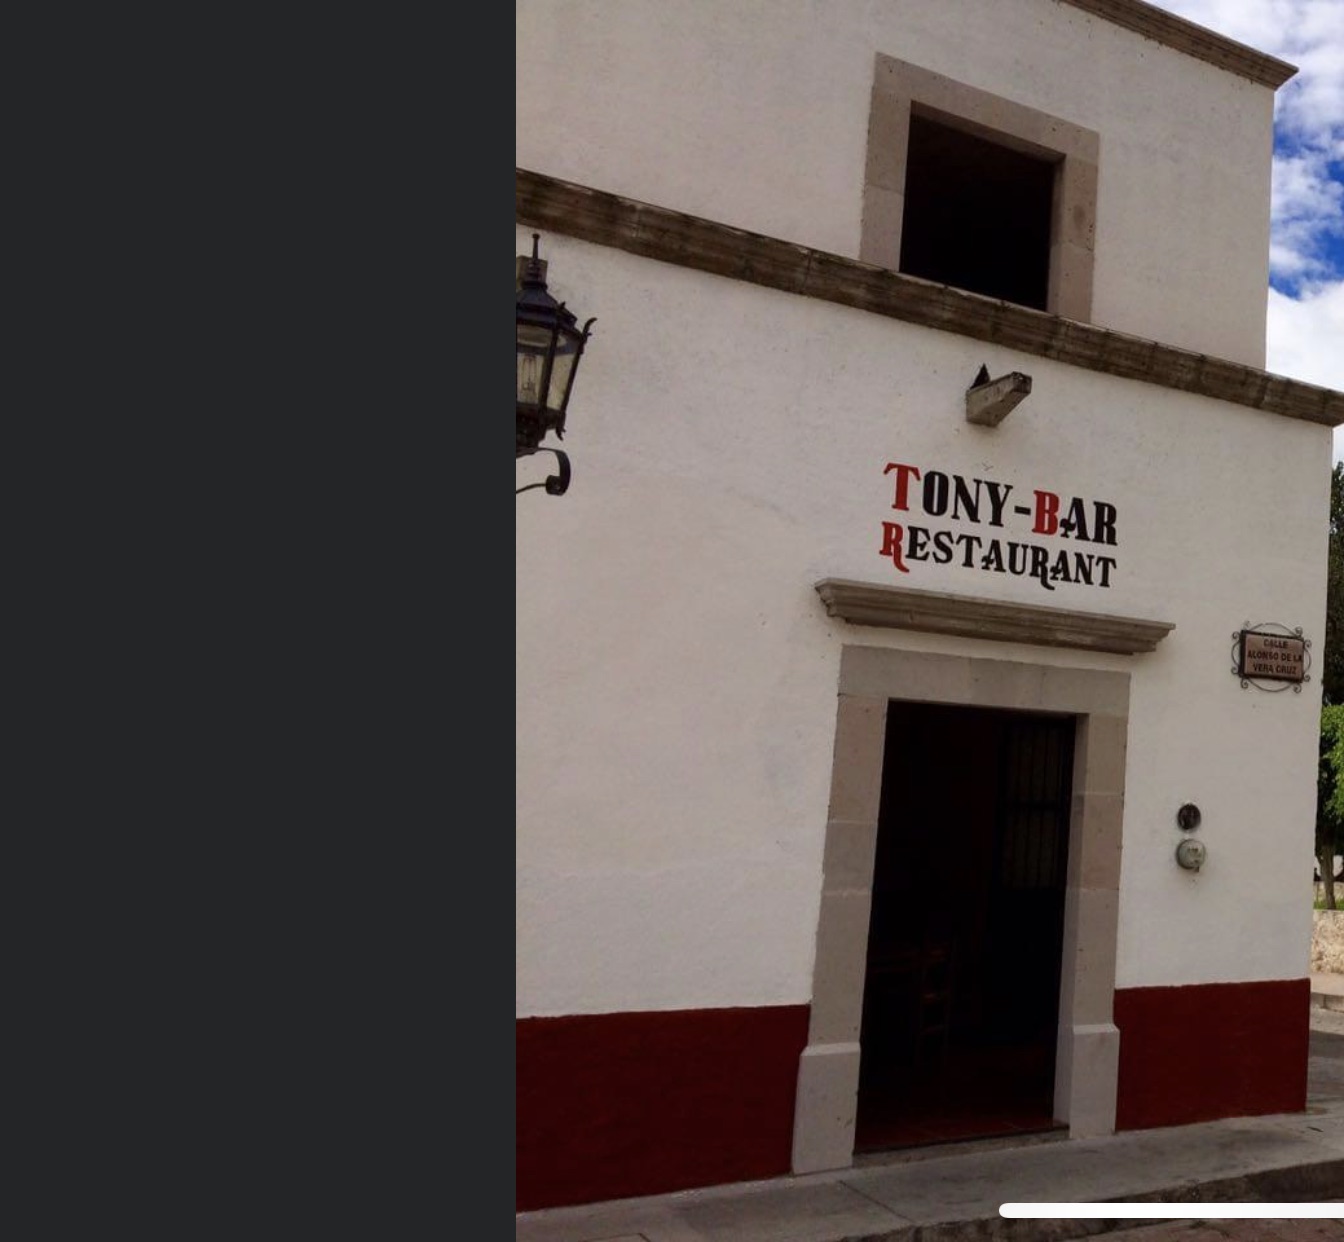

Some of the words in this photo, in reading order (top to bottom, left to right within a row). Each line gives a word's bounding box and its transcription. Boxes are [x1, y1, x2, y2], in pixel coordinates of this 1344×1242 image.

[883, 462, 1118, 546] TONY-BAR
[879, 521, 1117, 590] RESTAURANT
[1263, 639, 1289, 649] CALLE
[1247, 650, 1279, 660] ALONSO
[1281, 653, 1292, 662] DE
[1253, 663, 1274, 674] VERA
[1276, 665, 1297, 675] CRUZ
